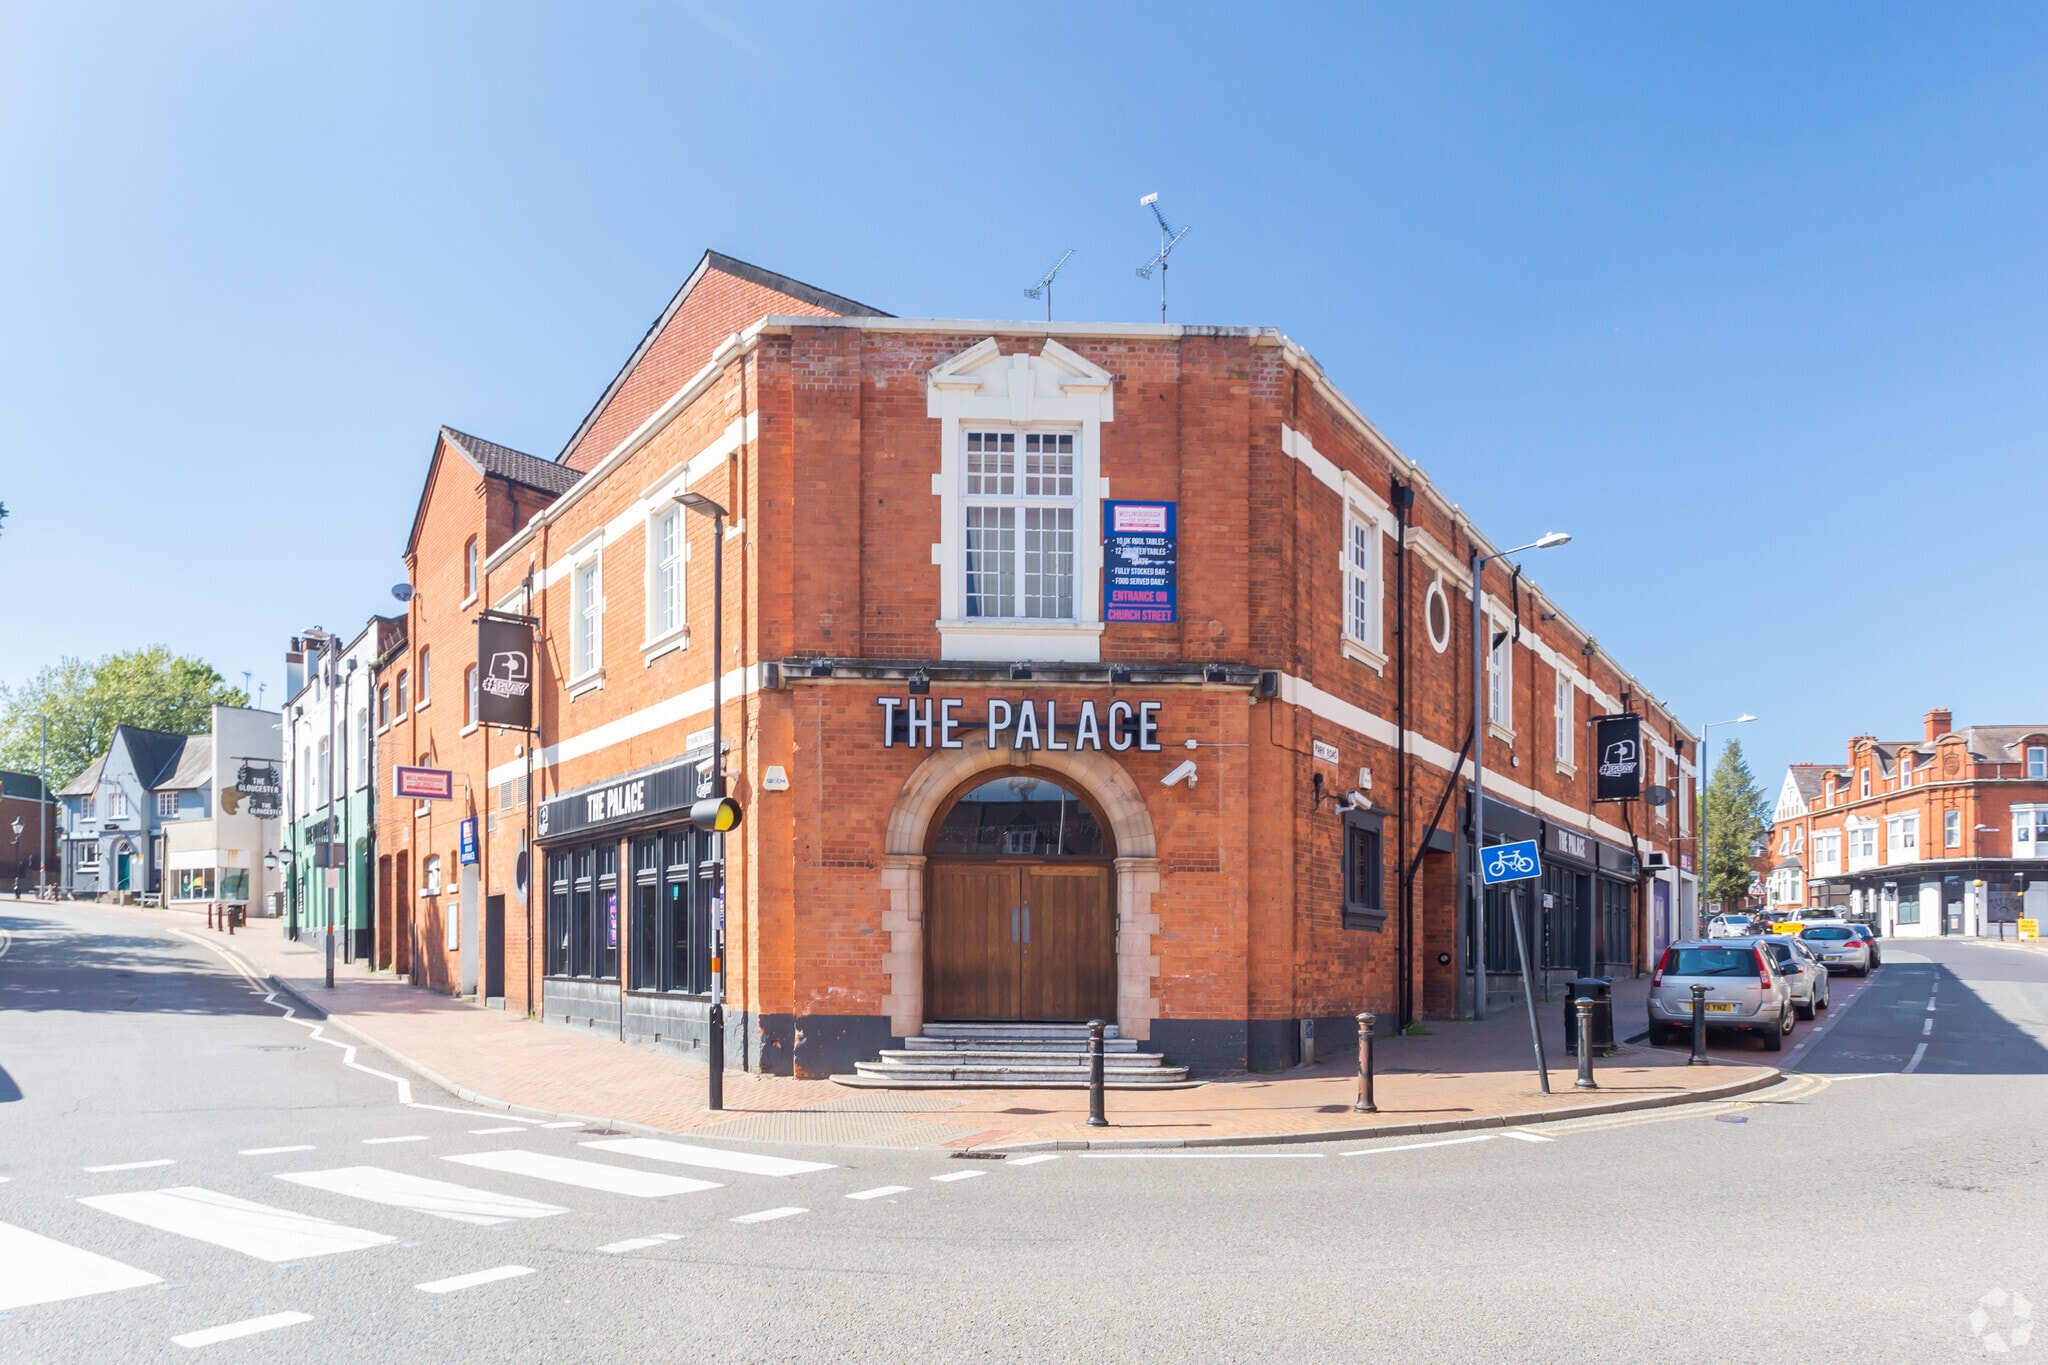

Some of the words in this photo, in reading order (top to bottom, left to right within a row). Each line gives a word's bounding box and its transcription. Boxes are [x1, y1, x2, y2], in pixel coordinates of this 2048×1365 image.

[1116, 537, 1123, 545] 10
[1123, 537, 1132, 545] UK
[1145, 537, 1165, 546] TABLES
[1147, 547, 1166, 556] TABLES
[1114, 567, 1131, 575] FULLY
[1130, 567, 1154, 576] STOCKED
[1154, 568, 1166, 576] BAR
[1115, 577, 1129, 585] FOOD
[1129, 577, 1150, 585] SERVED
[1150, 577, 1166, 586] DAILY
[1112, 590, 1154, 602] ENTRANCE
[1155, 591, 1168, 602] ON
[1108, 609, 1140, 621] CHURCH
[1141, 609, 1172, 621] STREET
[877, 697, 963, 749] THE
[987, 698, 1163, 752] PALACE
[252, 777, 265, 785] THE
[239, 784, 279, 793] GLOUCESTER
[586, 790, 605, 823] THE
[606, 780, 645, 819] PALACE
[1558, 829, 1569, 853] THE
[1568, 834, 1585, 858] PALACE
[1712, 1003, 1727, 1011] YNZ
